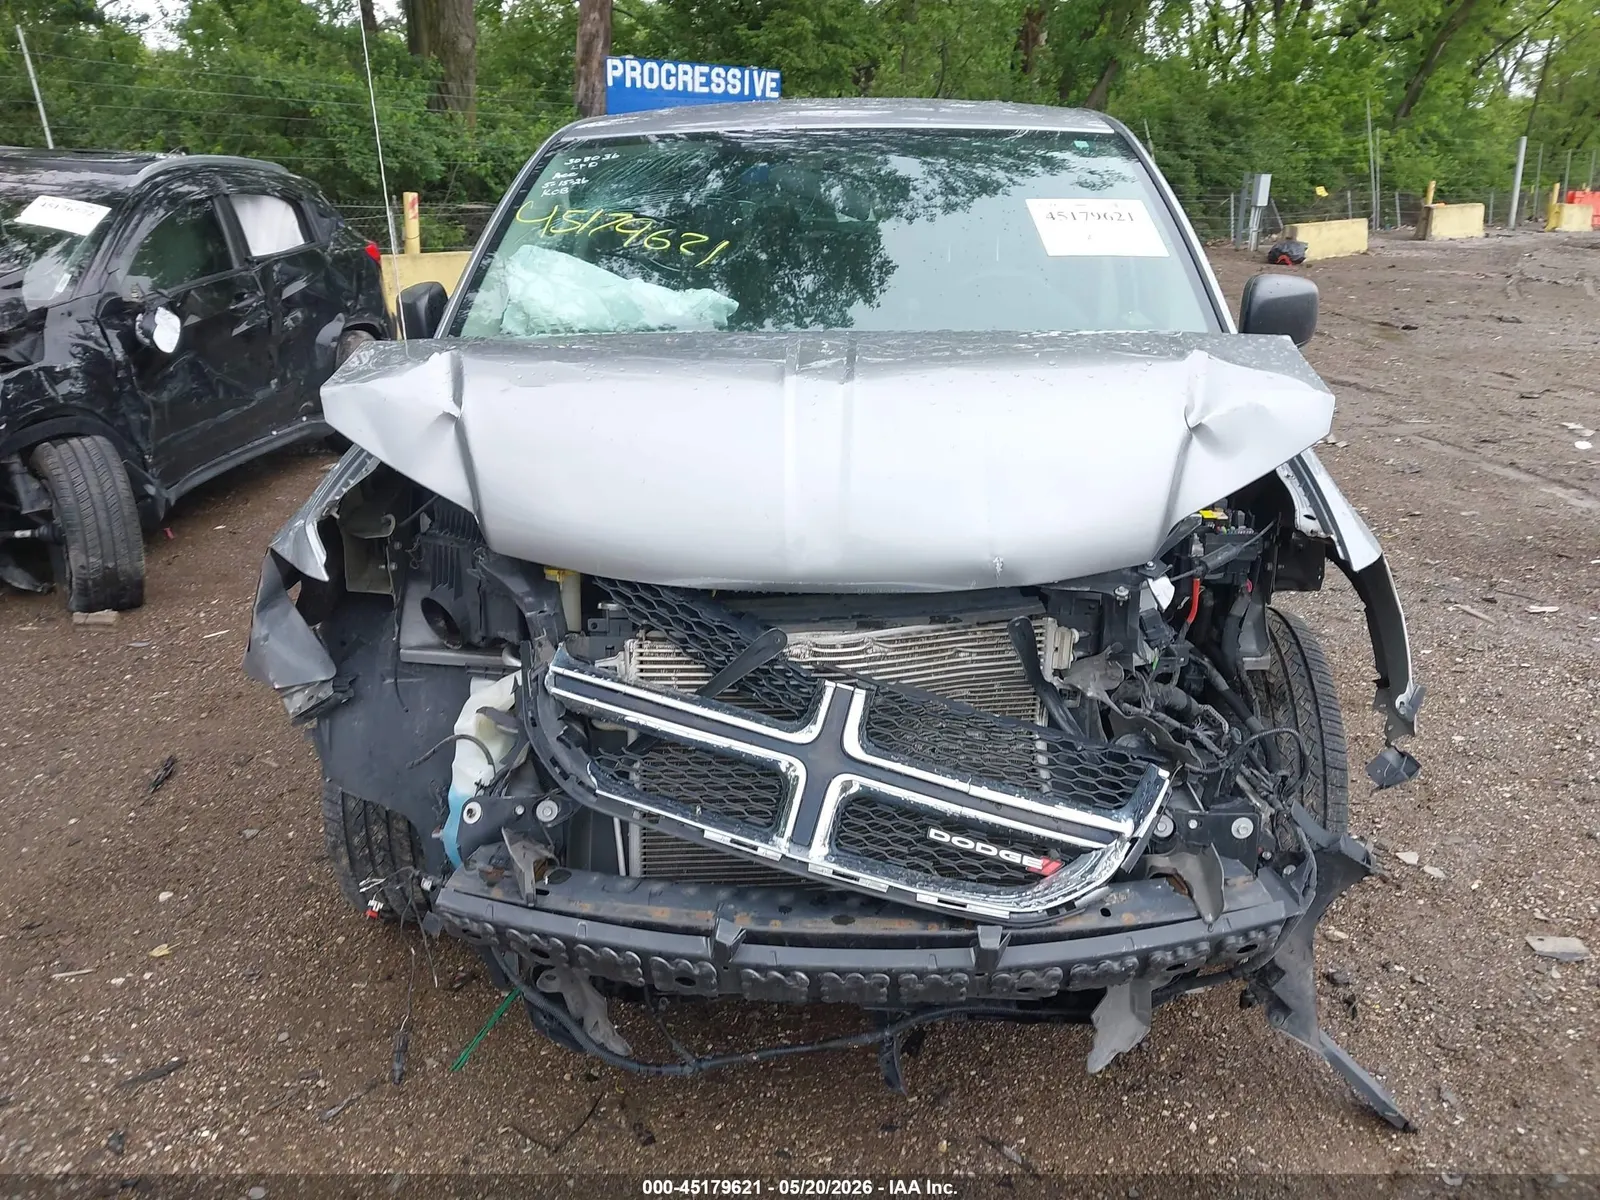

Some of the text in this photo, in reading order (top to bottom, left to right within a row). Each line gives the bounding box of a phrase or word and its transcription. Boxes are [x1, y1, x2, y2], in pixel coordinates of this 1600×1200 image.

[606, 58, 781, 98] PROGRESSIVE
[515, 200, 730, 268] 45179621
[1045, 210, 1135, 223] 45179621
[928, 827, 1044, 871] DODGE
